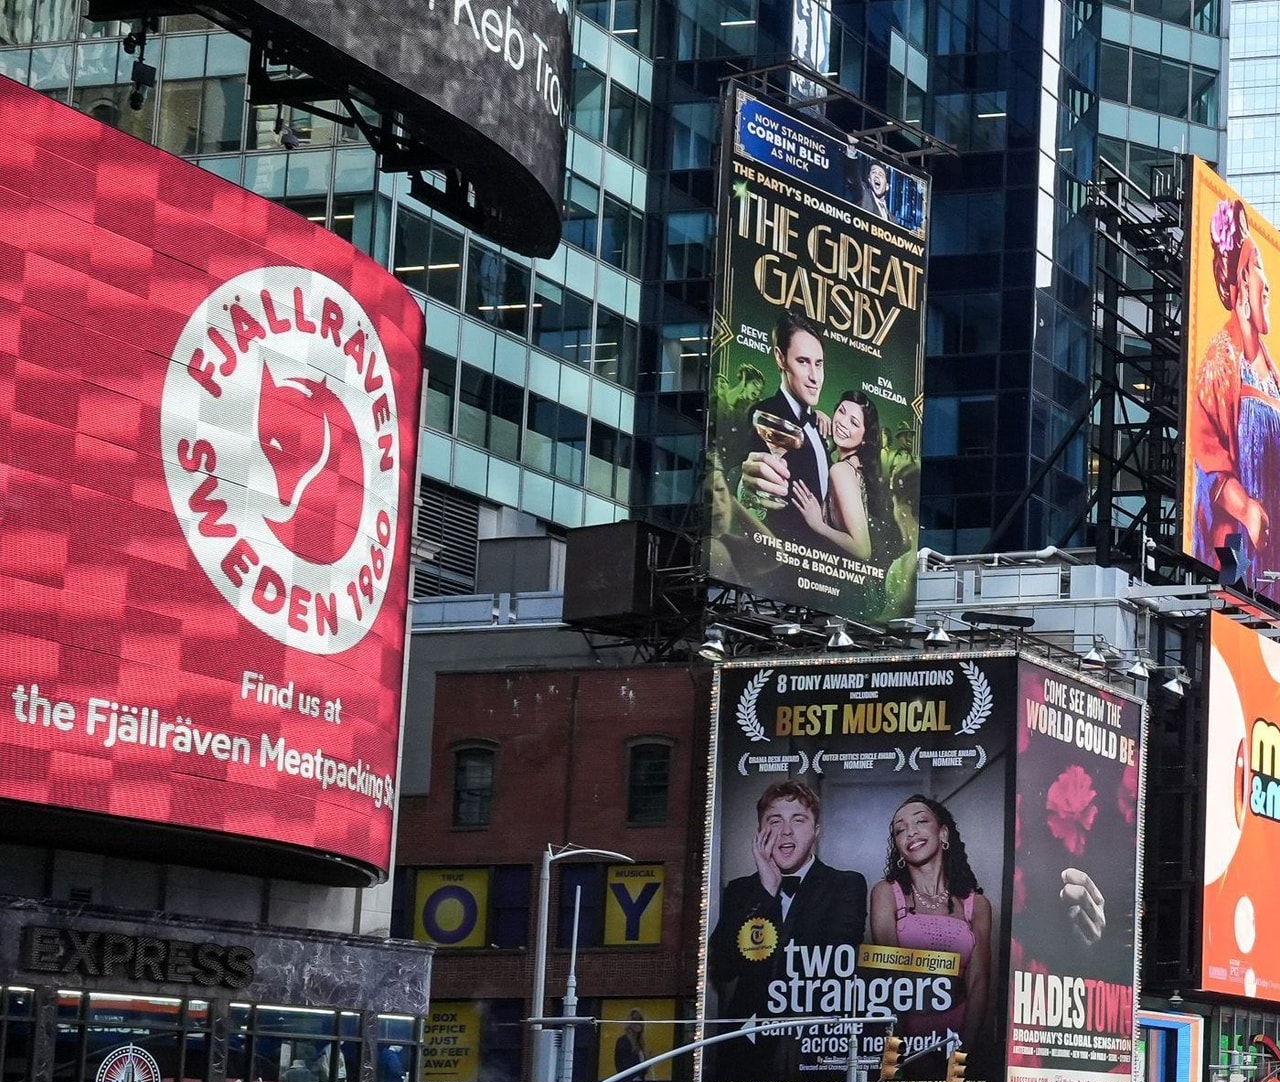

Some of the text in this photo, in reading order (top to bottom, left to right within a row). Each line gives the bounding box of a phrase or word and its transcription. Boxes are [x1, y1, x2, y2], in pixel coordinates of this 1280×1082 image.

[747, 122, 830, 170] CORBIN BLEU
[755, 113, 826, 154] NOW STARRING
[770, 147, 810, 172] AS NICK
[733, 161, 924, 257] THE ROARING ON BROADWAY
[734, 186, 923, 310] THE GREAT
[754, 254, 901, 346] GATSBY
[785, 541, 885, 580] BROADWAY THEATRE
[801, 558, 866, 585] & BROADWAY
[241, 670, 343, 725] Find us at
[777, 670, 954, 693] 8 TONY NOMINATIONS
[12, 684, 75, 731] the
[776, 700, 951, 736] BEST MUSICAL
[1043, 677, 1123, 730] COME SEE THE
[1026, 698, 1135, 767] WORLD COULD BE
[758, 762, 789, 772] NOMINEE
[843, 760, 874, 770] NOMINEE
[932, 757, 963, 767] NOMINEE
[615, 869, 656, 879] MUSICAL
[26, 926, 256, 990] EXPRESS
[784, 938, 856, 979] two
[863, 951, 956, 972] a musical original
[767, 975, 953, 1018] strangers
[1013, 970, 1133, 1034] HADESTOWN
[432, 1013, 458, 1023] BOX
[429, 1036, 458, 1046] JUST
[440, 1047, 470, 1057] FEET
[1013, 1027, 1091, 1049] BROADWAY'S GLOBAL
[424, 1059, 460, 1069] AWAY
